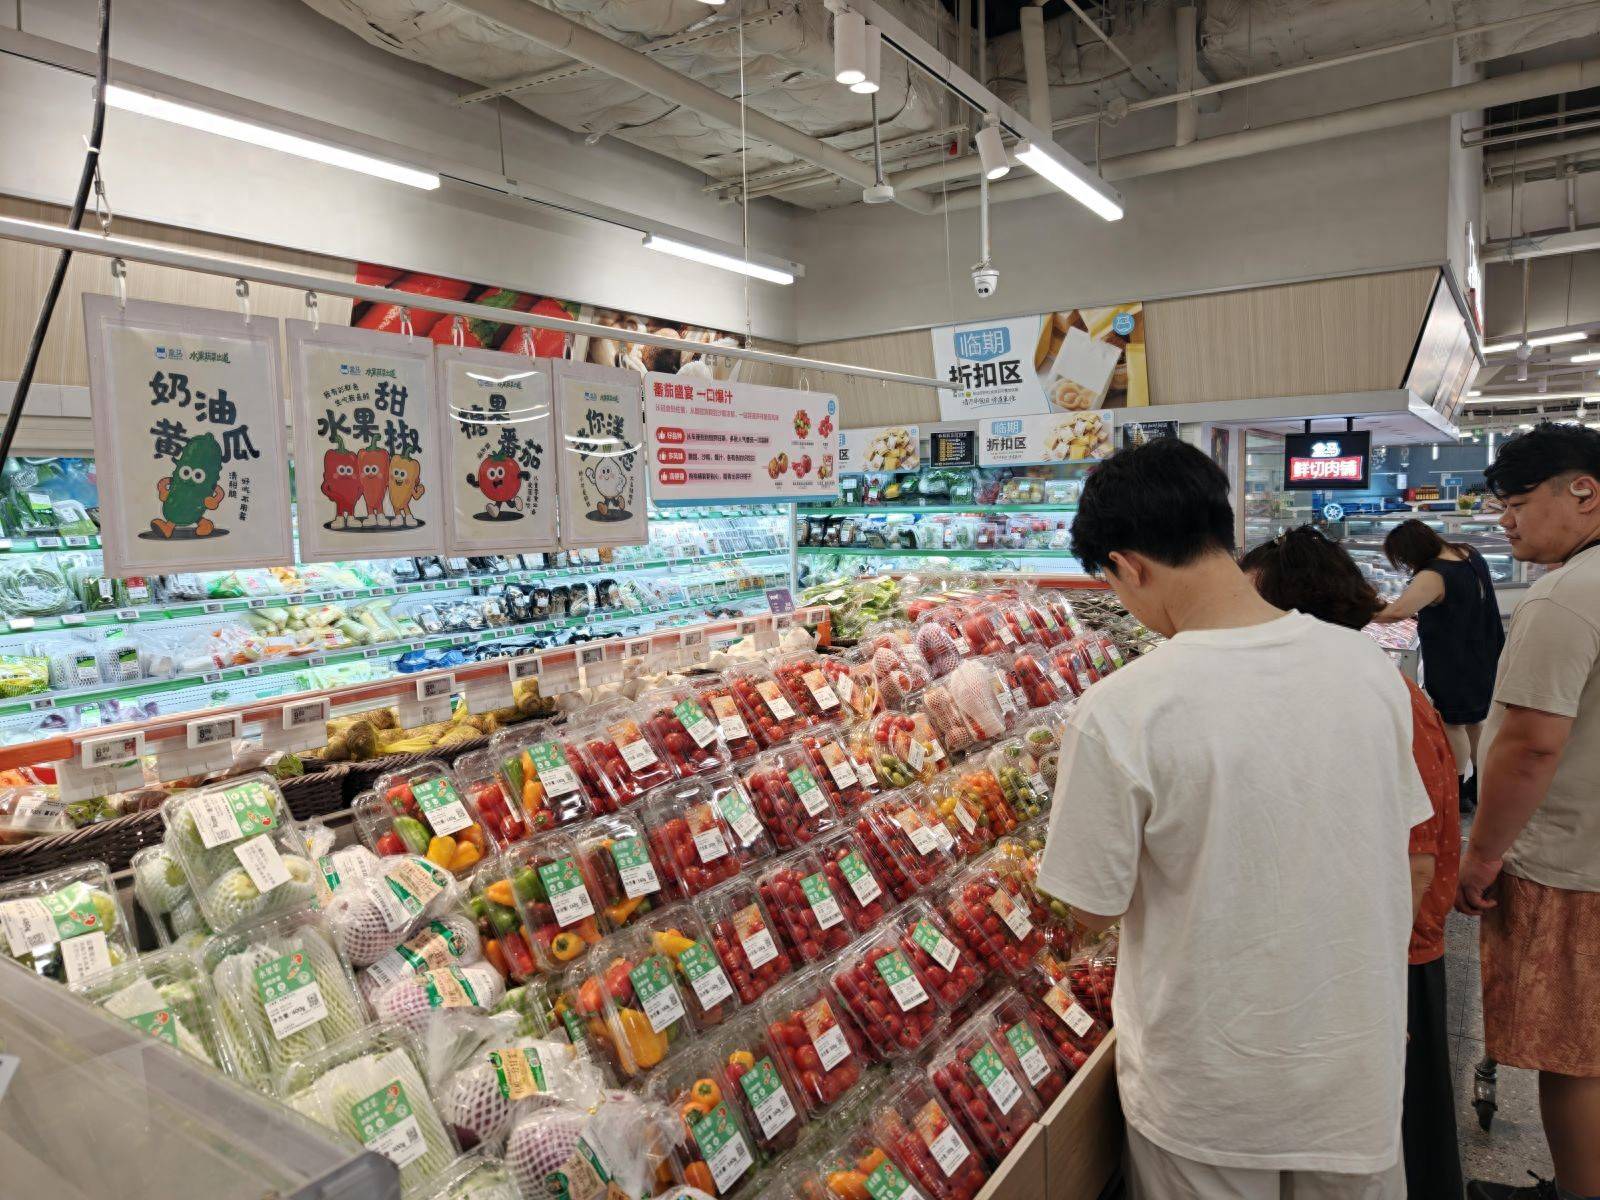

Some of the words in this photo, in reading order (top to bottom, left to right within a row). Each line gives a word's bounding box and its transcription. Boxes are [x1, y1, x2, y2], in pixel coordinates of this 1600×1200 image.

[960, 331, 1005, 357] 临期
[949, 360, 1023, 389] 折扣区
[149, 371, 237, 425] 奶油
[653, 382, 693, 400] 番茄盛宴
[696, 388, 733, 404] 一口爆汁
[150, 418, 260, 464] 黄瓜
[994, 421, 1019, 436] 临期
[498, 427, 544, 470] 番茄
[986, 437, 1027, 451] 折扣区
